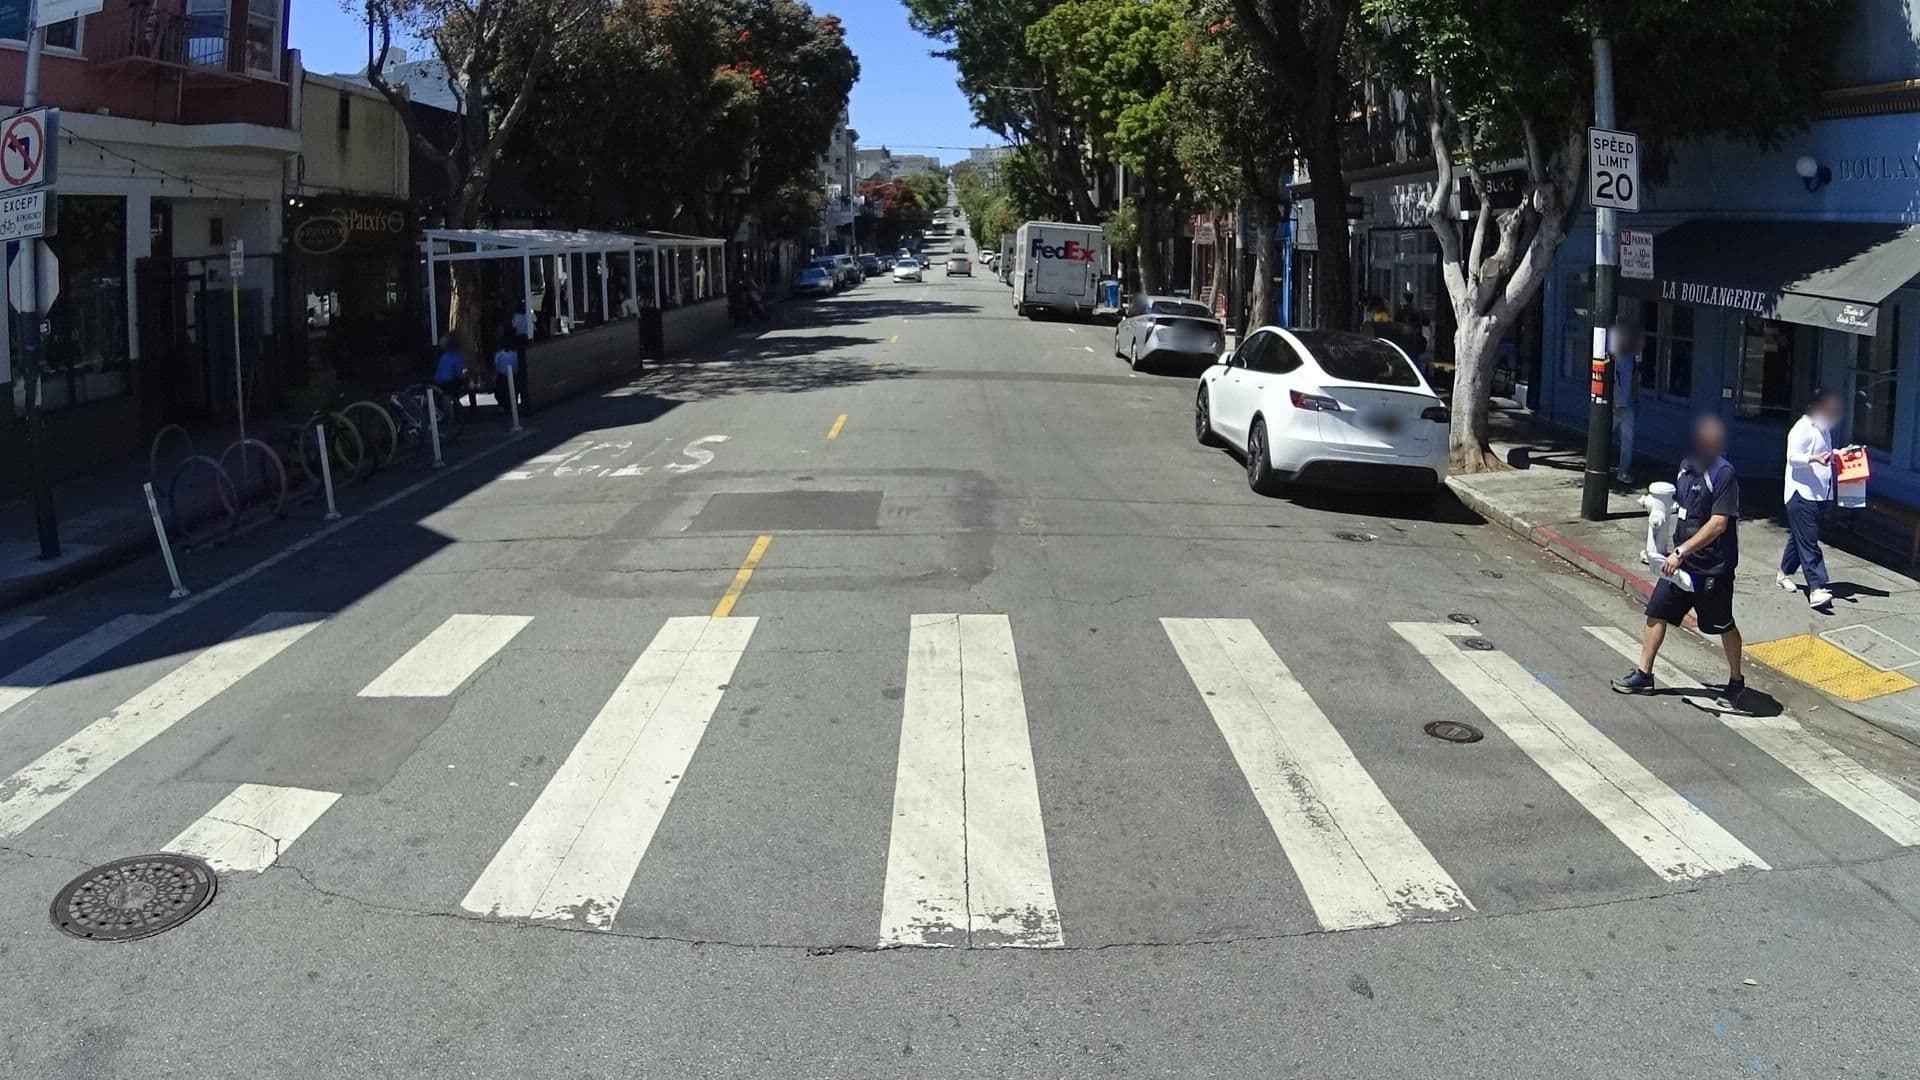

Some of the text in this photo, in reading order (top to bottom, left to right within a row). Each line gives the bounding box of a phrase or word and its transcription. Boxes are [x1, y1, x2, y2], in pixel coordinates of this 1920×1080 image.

[1593, 137, 1634, 154] SPEED
[1598, 154, 1630, 169] LIMIT
[1596, 170, 1633, 201] 20
[4, 195, 38, 213] EXCEPT
[350, 207, 386, 232] Patxi's
[1621, 231, 1651, 246] NO PARKING
[1031, 238, 1095, 261] FedEx
[1662, 280, 1766, 312] LA BOULANGERIE
